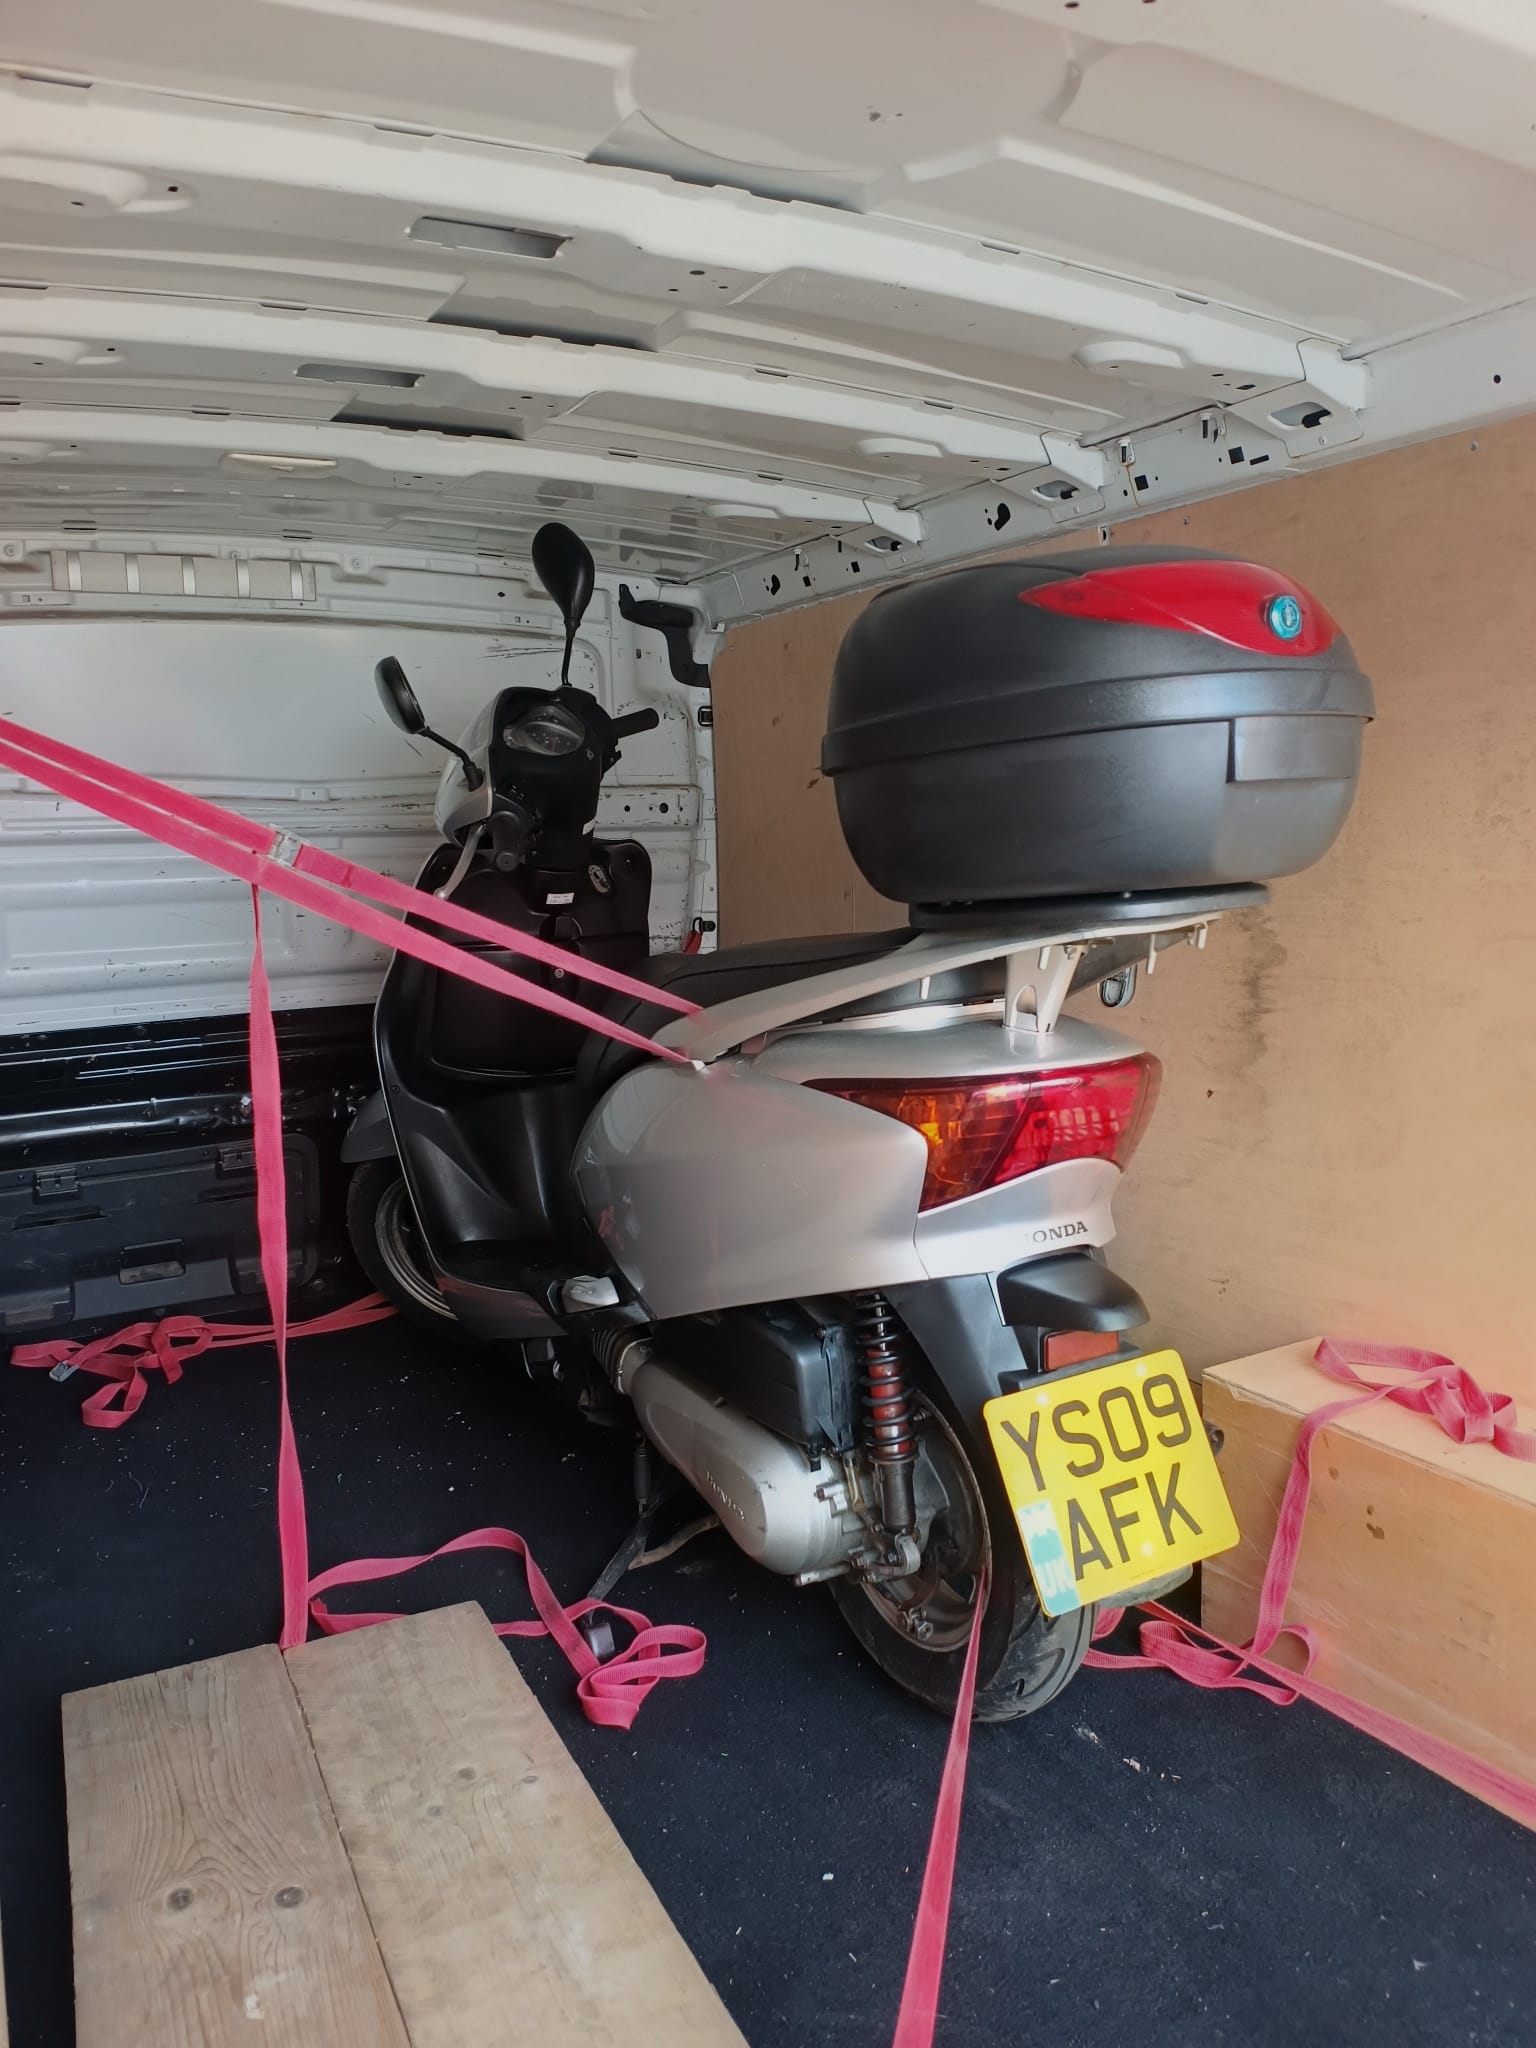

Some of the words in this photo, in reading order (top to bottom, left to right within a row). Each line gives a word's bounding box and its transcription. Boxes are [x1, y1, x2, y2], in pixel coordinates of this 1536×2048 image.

[1023, 1220, 1089, 1243] ONDA
[1000, 1373, 1192, 1492] YS09
[1067, 1462, 1203, 1582] AFK
[1034, 1556, 1076, 1599] UK
